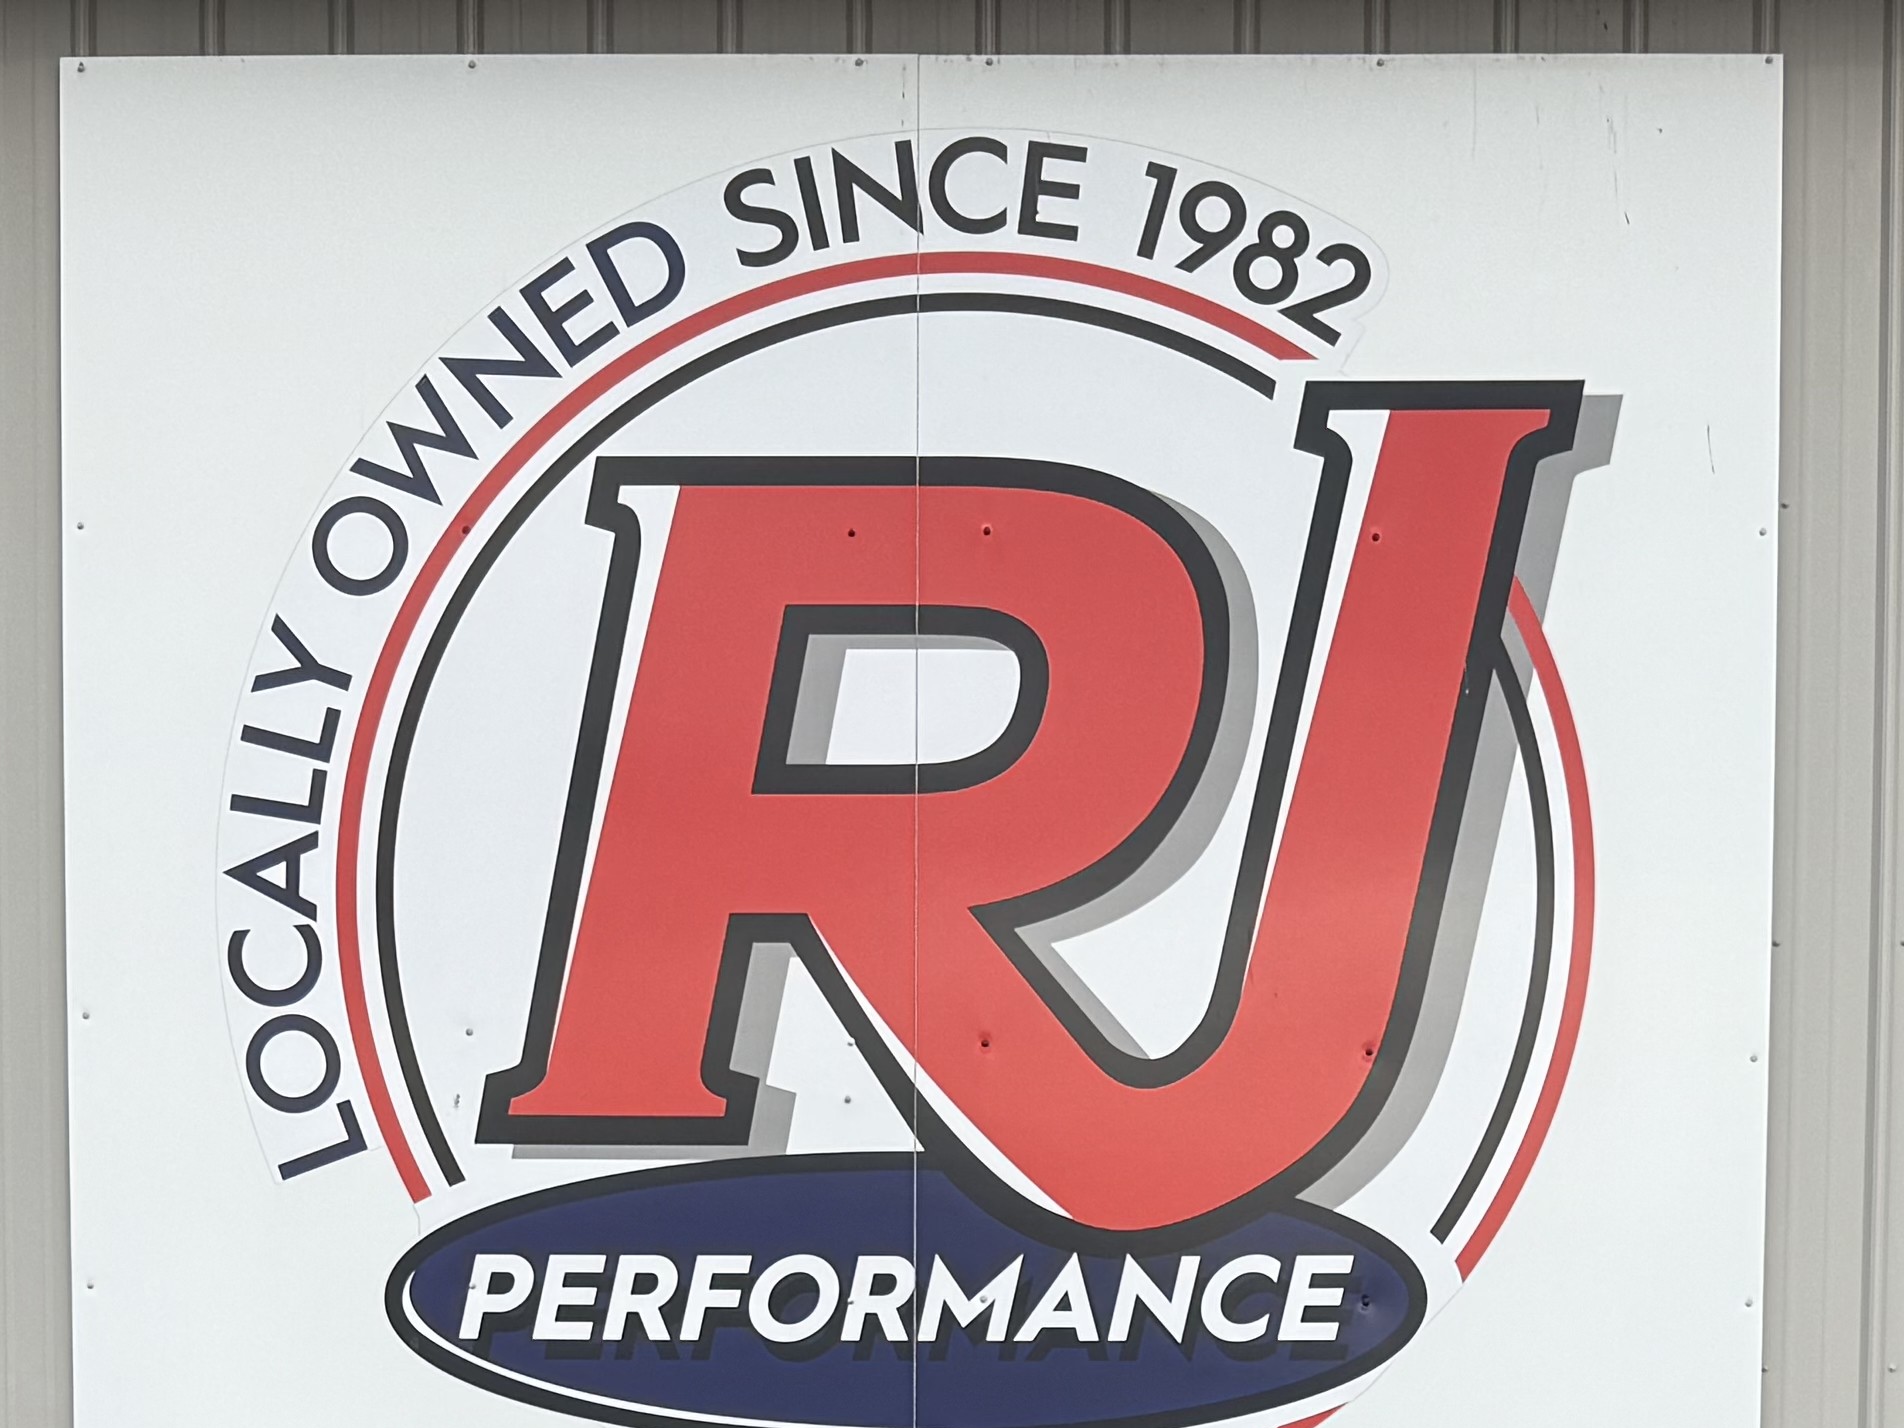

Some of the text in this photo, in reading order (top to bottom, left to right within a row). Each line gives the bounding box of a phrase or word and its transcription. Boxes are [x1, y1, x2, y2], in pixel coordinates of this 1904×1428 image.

[223, 137, 1371, 1180] LOCALLY OWNED SINCE 1982
[476, 380, 1585, 1252] RJ
[459, 1253, 1354, 1343] PERFORMANCE
